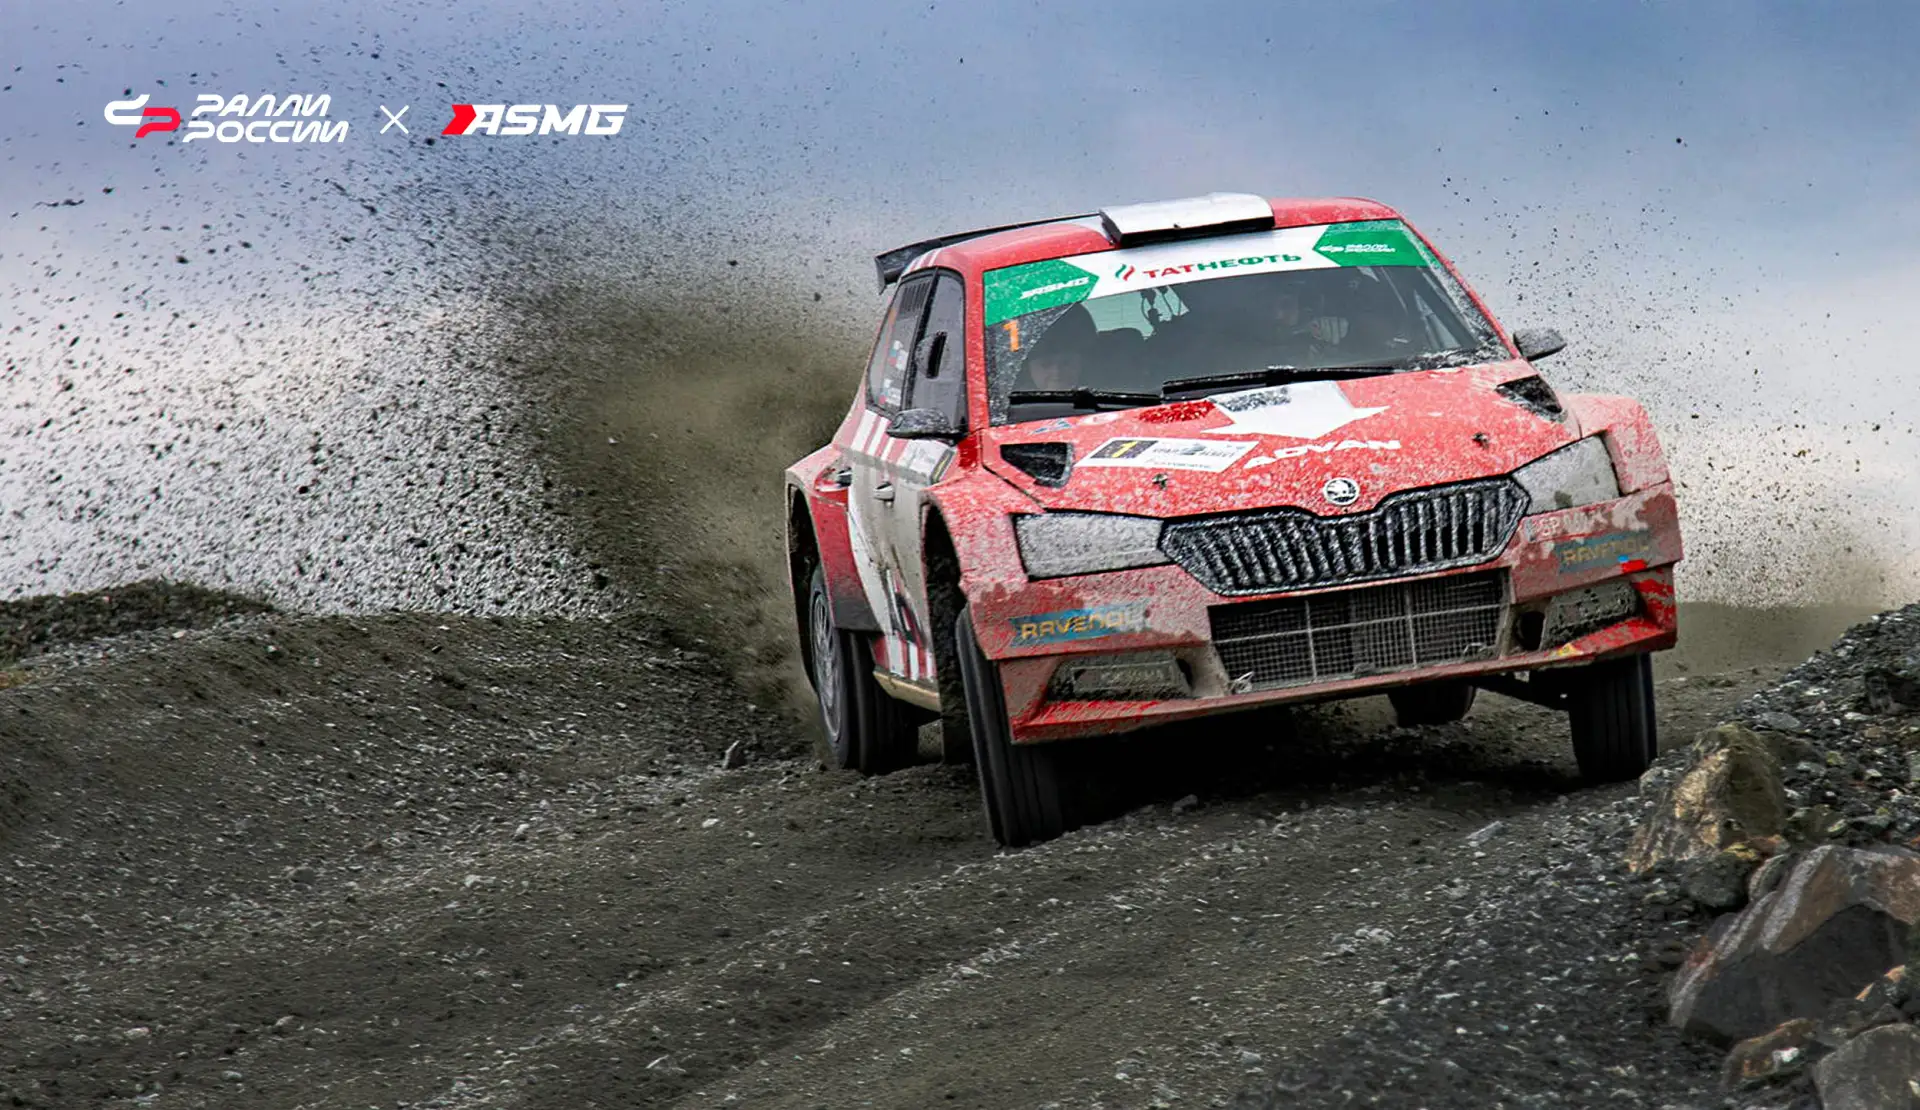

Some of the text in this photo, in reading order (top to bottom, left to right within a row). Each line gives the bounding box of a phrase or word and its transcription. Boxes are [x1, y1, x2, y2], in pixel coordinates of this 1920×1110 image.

[1142, 253, 1302, 279] ТАТНЕФТЬ
[1003, 319, 1020, 352] 1
[1111, 441, 1138, 458] 1
[1243, 440, 1402, 469] ADVAN
